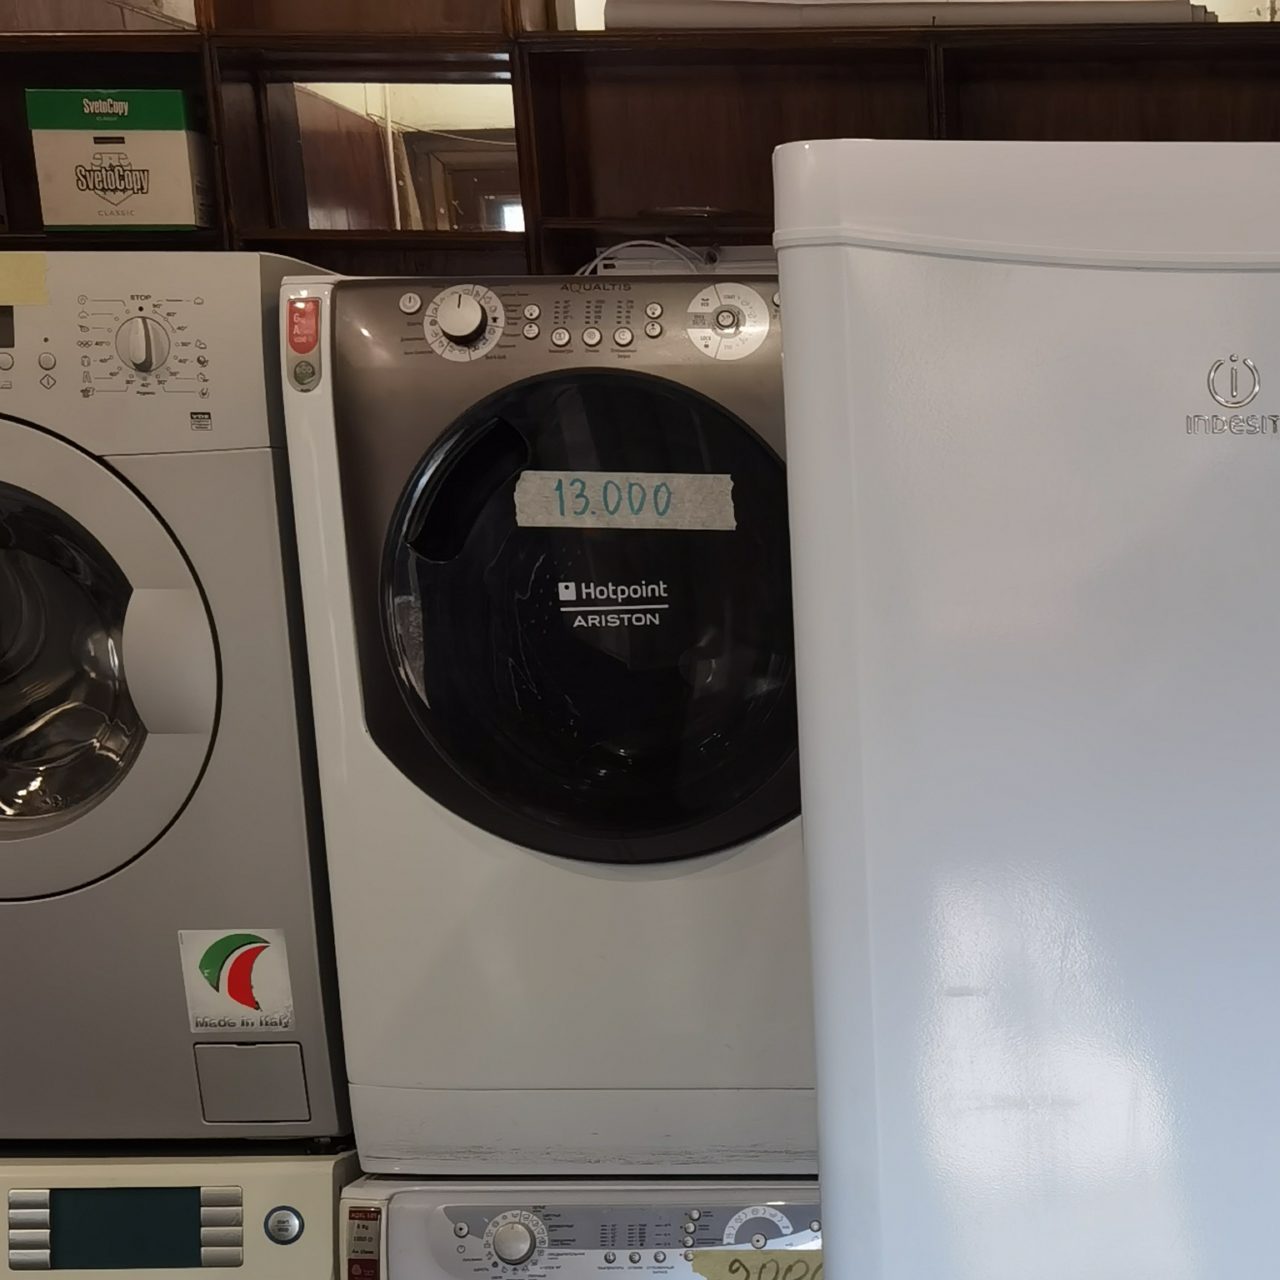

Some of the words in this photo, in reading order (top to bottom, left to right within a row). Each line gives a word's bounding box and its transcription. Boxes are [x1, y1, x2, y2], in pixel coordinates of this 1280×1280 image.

[83, 98, 128, 116] SvetoCopy
[75, 164, 149, 194] SvetoCopy
[560, 282, 632, 294] AQUALTIS
[555, 478, 673, 517] 13.000
[581, 580, 669, 603] Hotpoint
[573, 613, 660, 628] ARISTON
